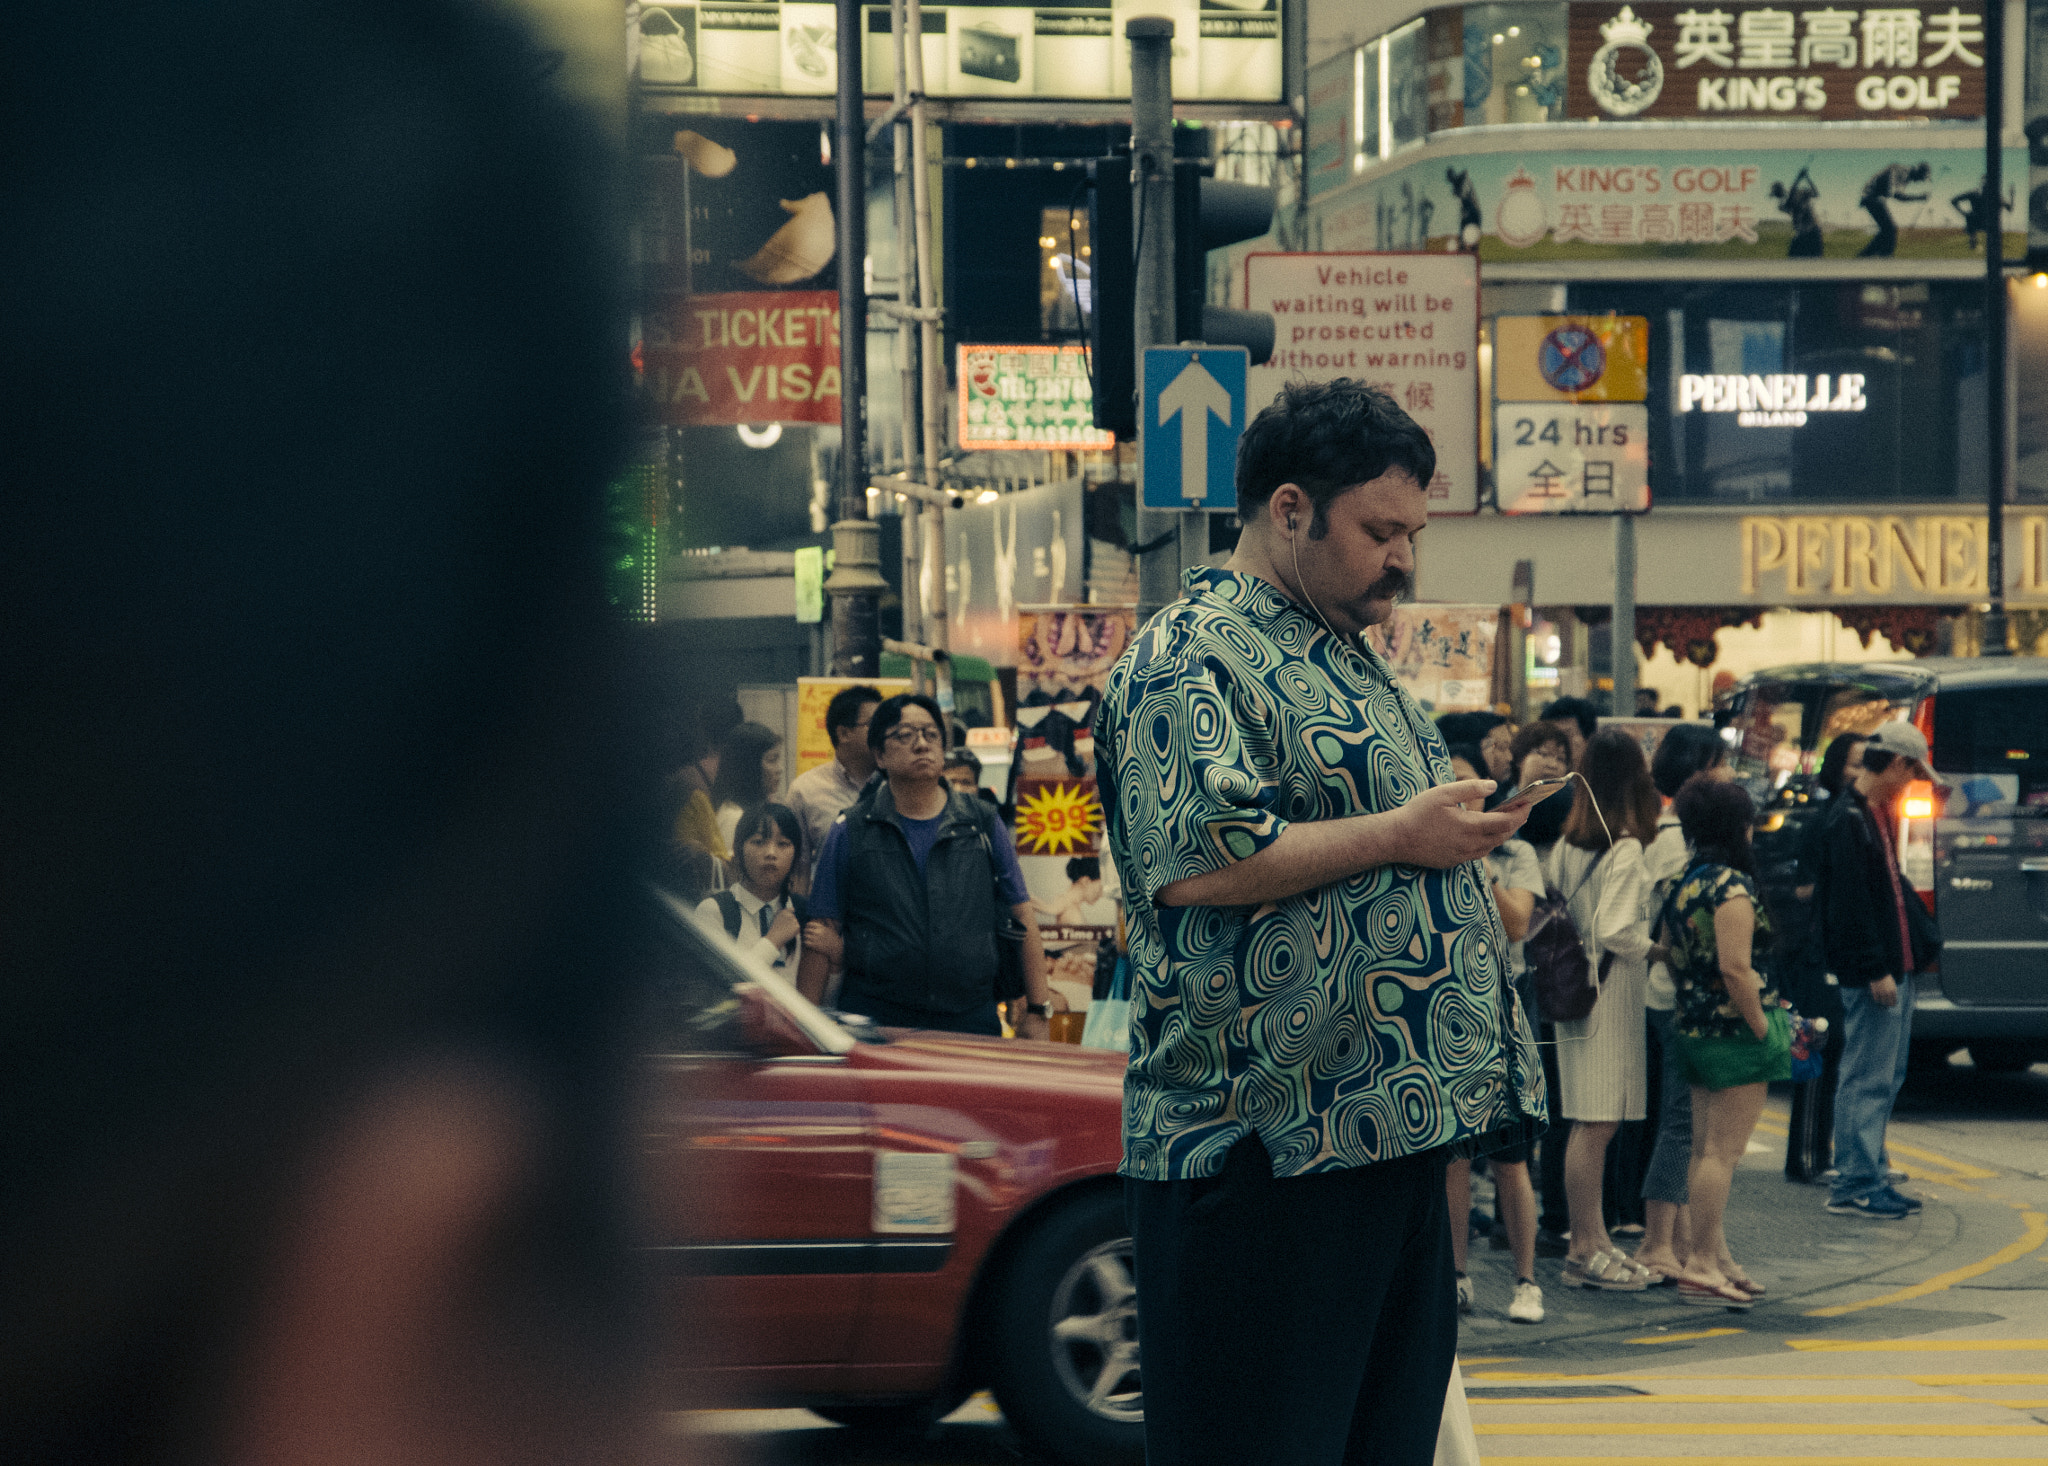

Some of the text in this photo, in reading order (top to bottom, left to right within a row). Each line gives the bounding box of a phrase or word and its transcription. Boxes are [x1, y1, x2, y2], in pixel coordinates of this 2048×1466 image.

[1674, 7, 1985, 69] 英皇高爾夫
[1699, 75, 1962, 112] KING'S GOLF
[1555, 166, 1758, 194] KING'S GOLF
[1555, 202, 1758, 242] 英皇高爾夫
[1317, 265, 1408, 286] Vehicle
[1272, 294, 1453, 315] waiting will be
[1291, 321, 1434, 344] prosecuted
[1366, 350, 1468, 370] warning
[1679, 373, 1867, 412] PERNELLE
[1515, 417, 1629, 446] 24 hrs
[1737, 411, 1808, 428] MILANO
[1527, 459, 1616, 499] 全日
[1027, 804, 1087, 837] $99
[1061, 927, 1094, 941] Time
